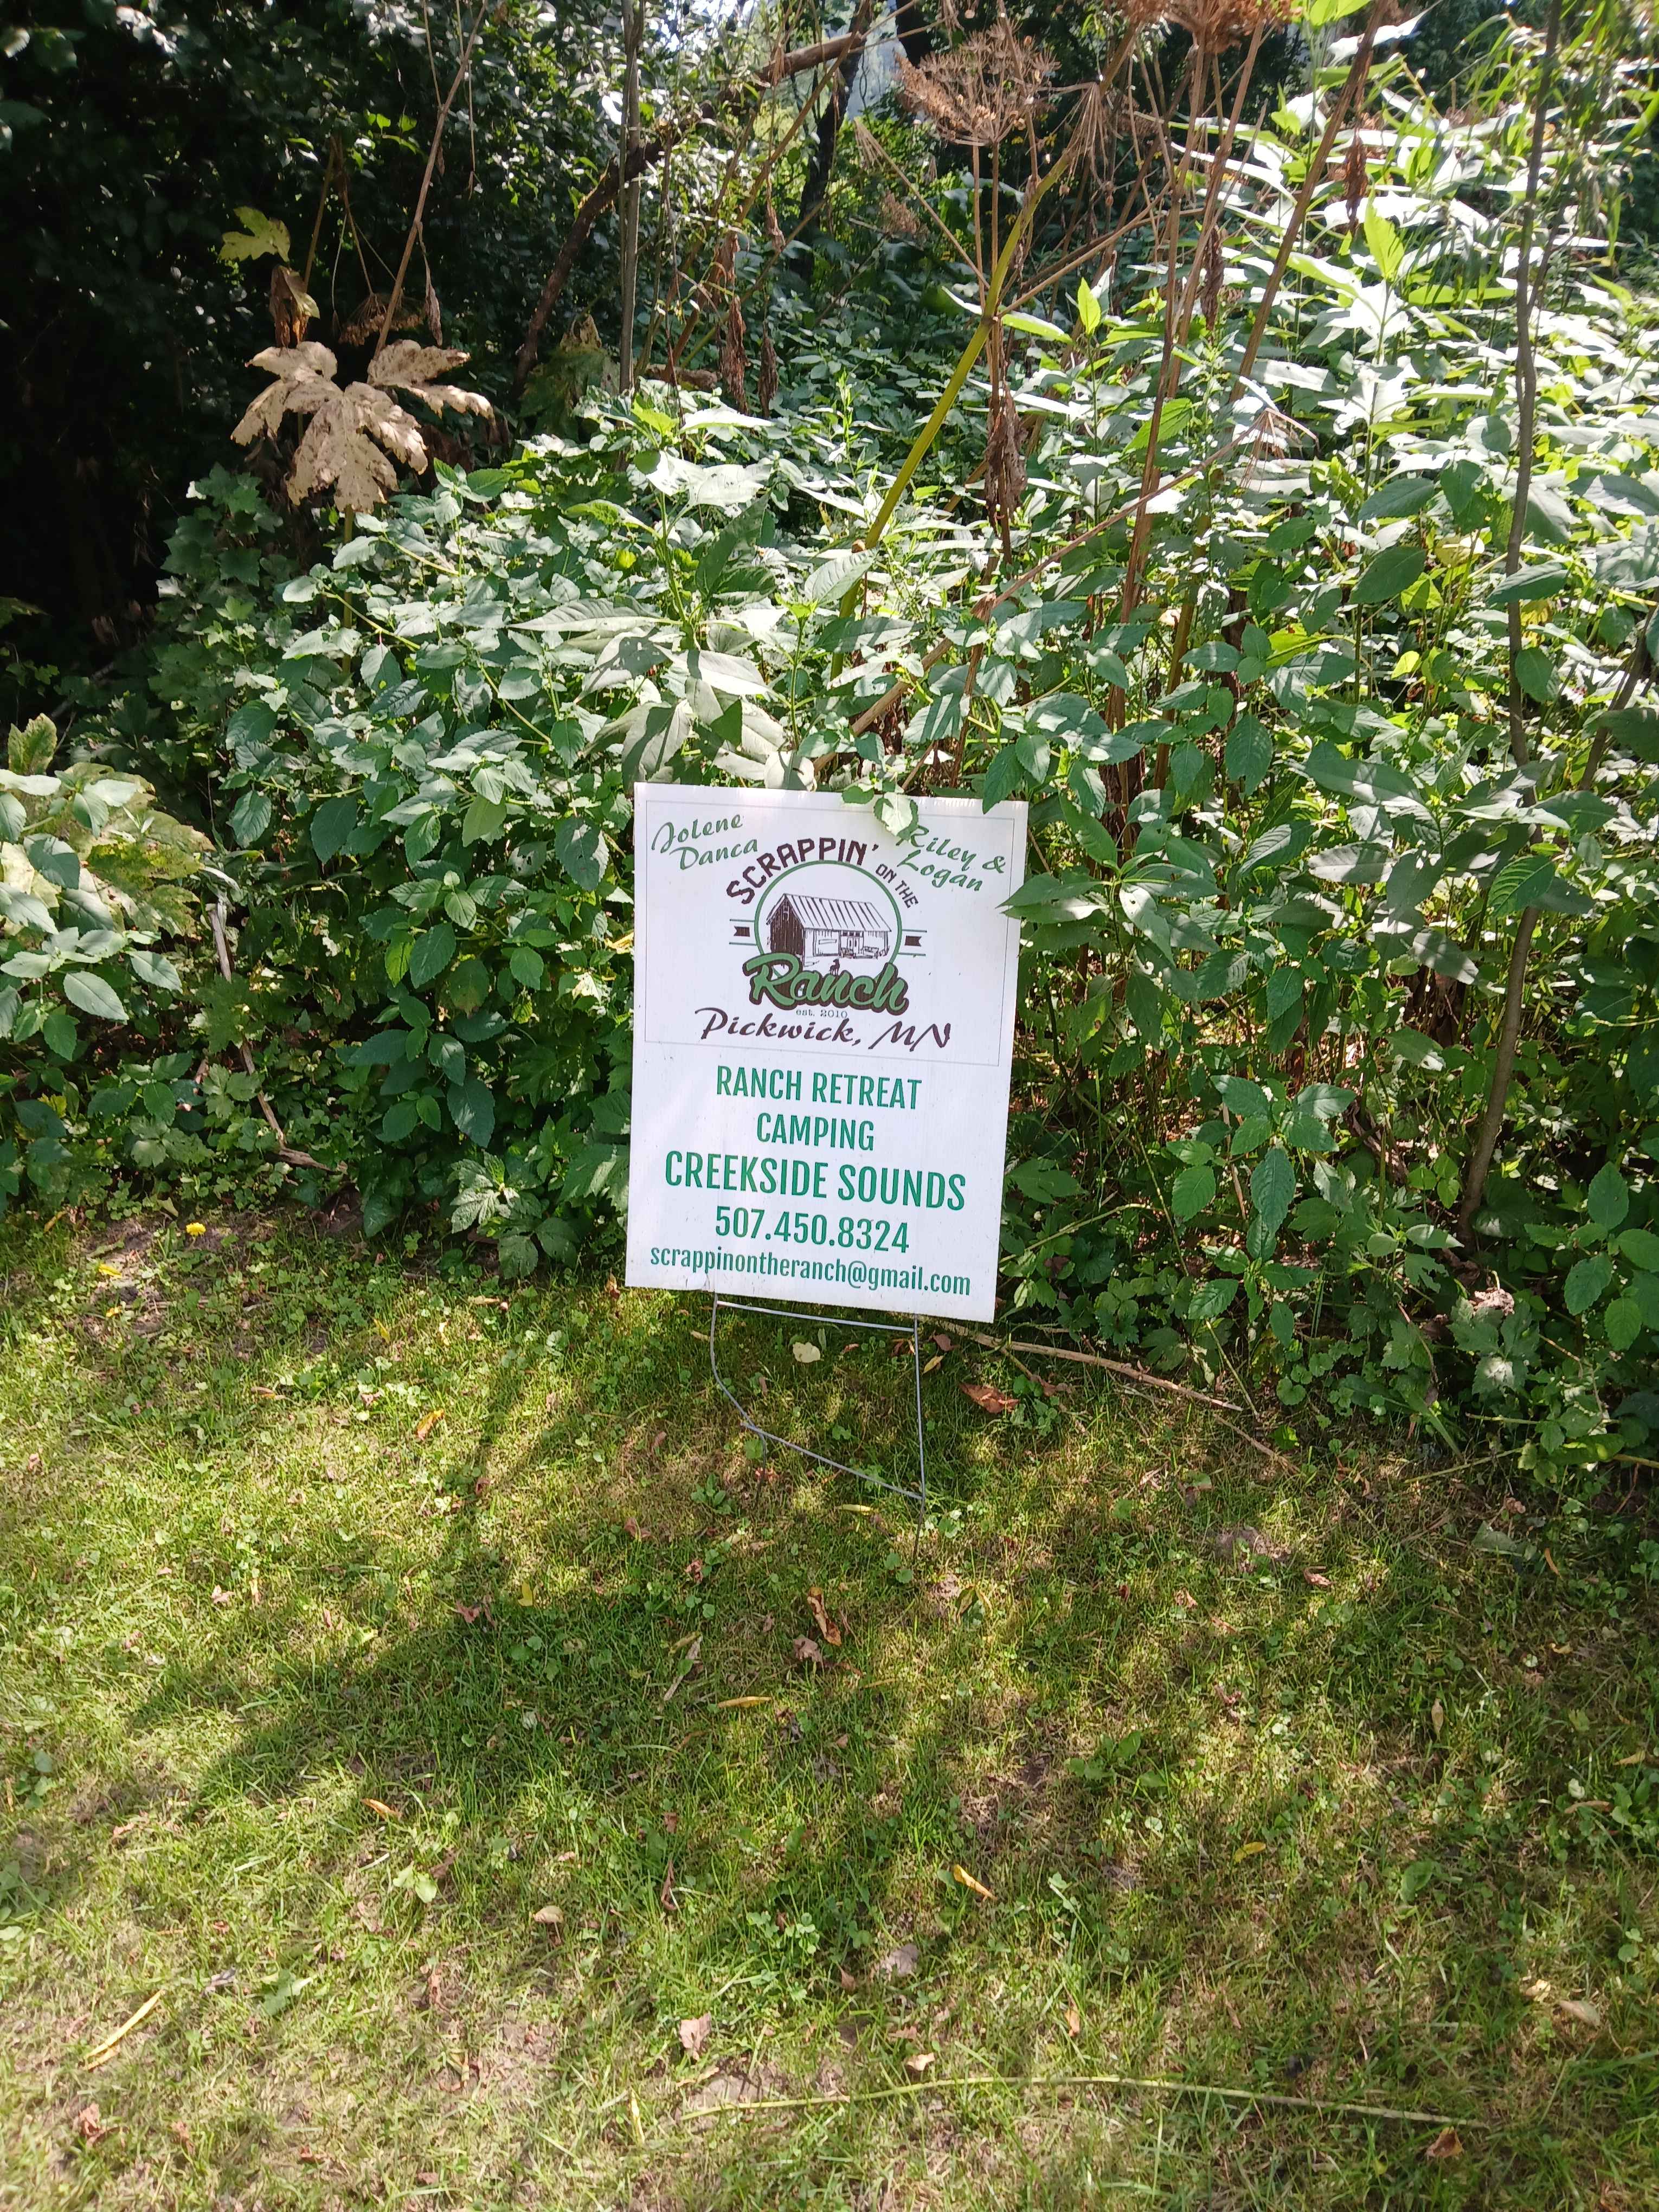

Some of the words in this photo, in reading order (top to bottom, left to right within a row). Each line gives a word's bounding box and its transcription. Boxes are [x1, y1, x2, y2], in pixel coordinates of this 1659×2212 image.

[651, 814, 743, 853] Jolene
[669, 839, 758, 871] Danca
[896, 824, 976, 872] Riley
[982, 856, 1006, 874] &
[726, 837, 879, 905] SCRAPPIN'
[875, 863, 897, 884] ON
[895, 880, 919, 909] THE
[896, 849, 983, 891] Logan
[742, 951, 910, 1015] Ranch
[695, 1007, 861, 1046] Pickwick,
[867, 1020, 951, 1052] MN
[820, 1009, 848, 1019] 2010
[716, 1065, 802, 1101] RANCH
[812, 1072, 922, 1110] RETREAT
[757, 1113, 874, 1151] CAMPING
[665, 1150, 828, 1199] CREEKSIDE
[838, 1164, 966, 1211] SOUNDS
[715, 1206, 910, 1254] 507.450.8324
[650, 1246, 971, 1296] scrappinontheranch@gmail.com
